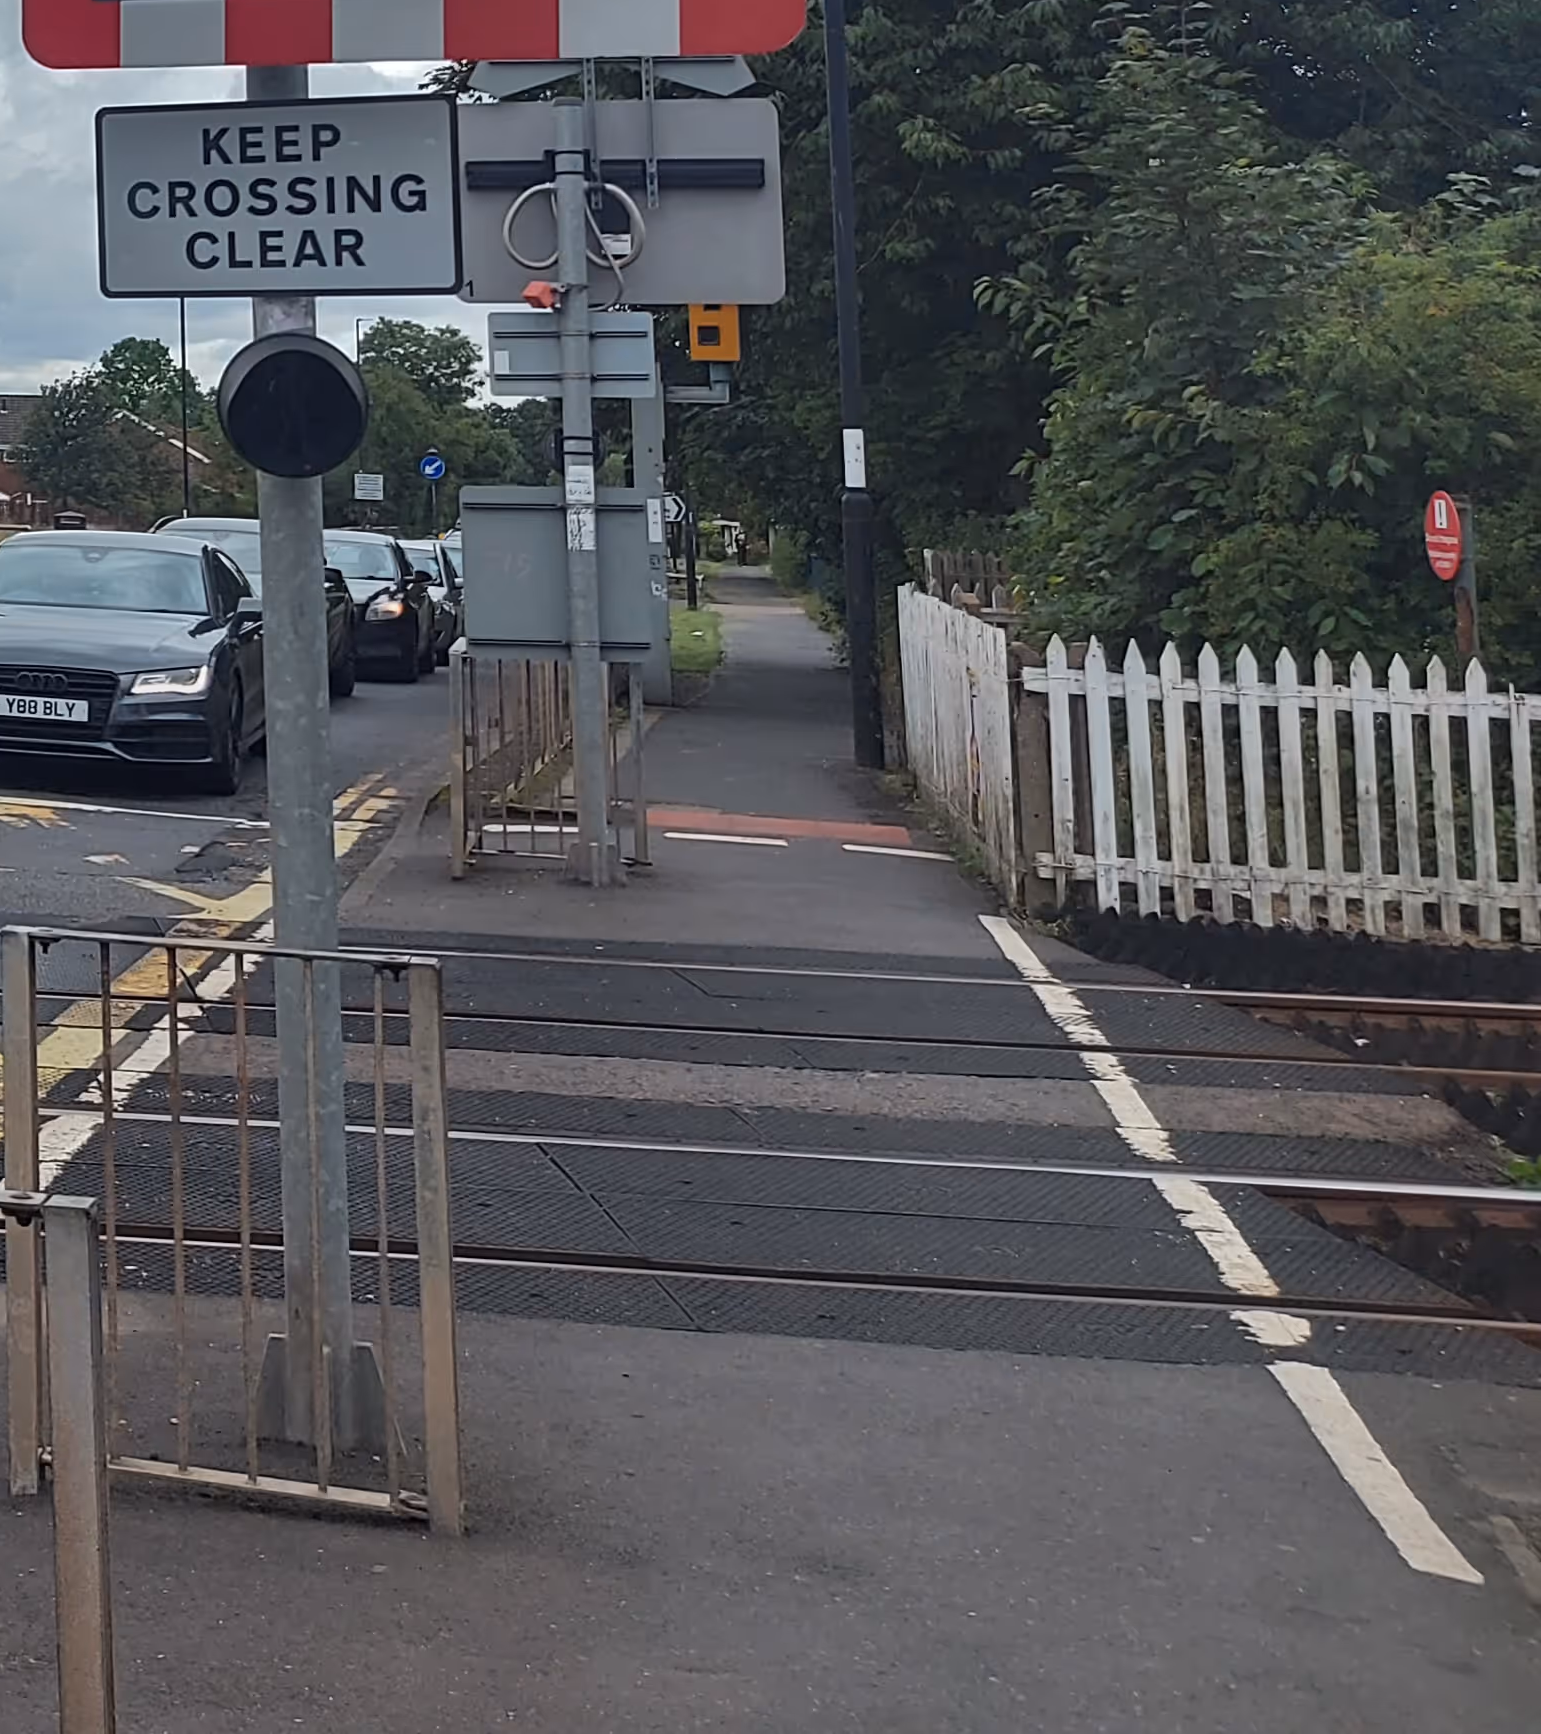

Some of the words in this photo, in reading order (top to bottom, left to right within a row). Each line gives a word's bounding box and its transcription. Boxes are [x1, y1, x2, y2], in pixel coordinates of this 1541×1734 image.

[201, 123, 341, 165] KEEP
[127, 173, 428, 219] CROSSING
[185, 228, 367, 269] CLEAR
[6, 698, 37, 714] Y88
[43, 700, 76, 718] BLY
